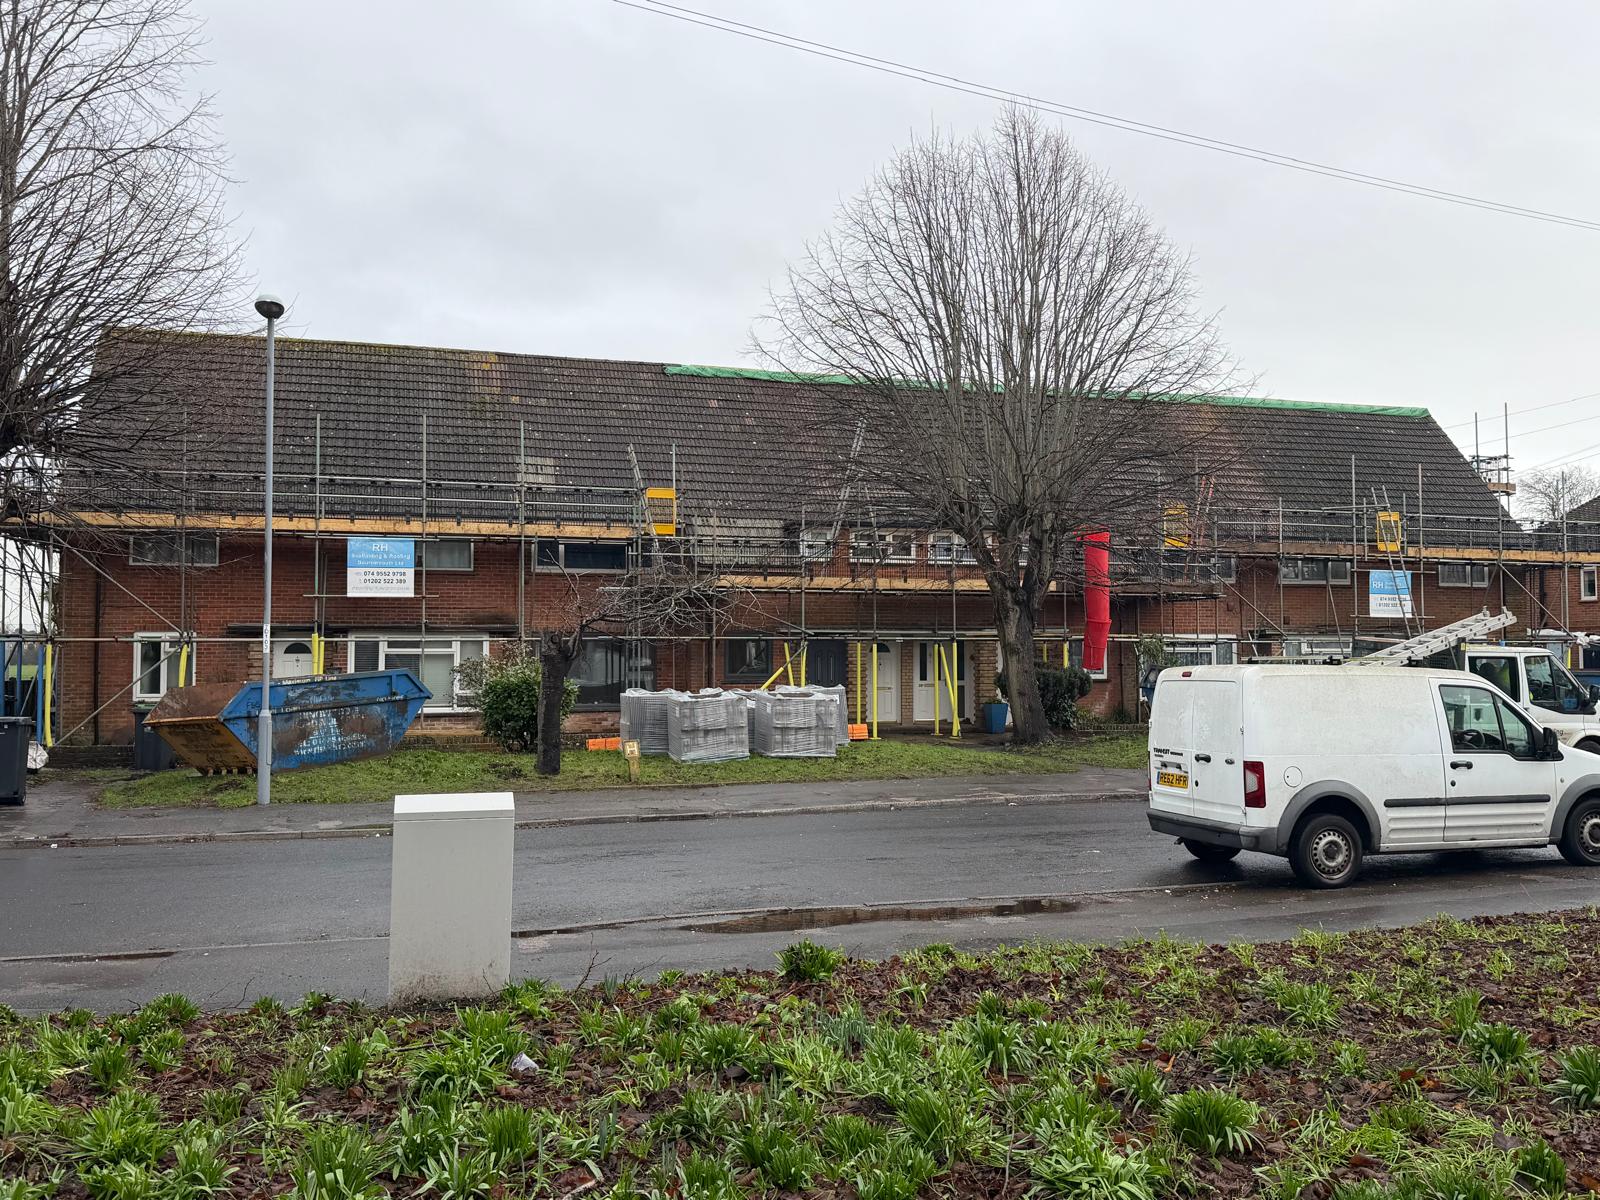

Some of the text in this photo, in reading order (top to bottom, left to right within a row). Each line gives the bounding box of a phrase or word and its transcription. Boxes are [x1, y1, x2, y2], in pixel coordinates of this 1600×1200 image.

[372, 543, 388, 552] RH
[1372, 581, 1384, 589] RH
[1160, 772, 1187, 787] RE62 HFR
